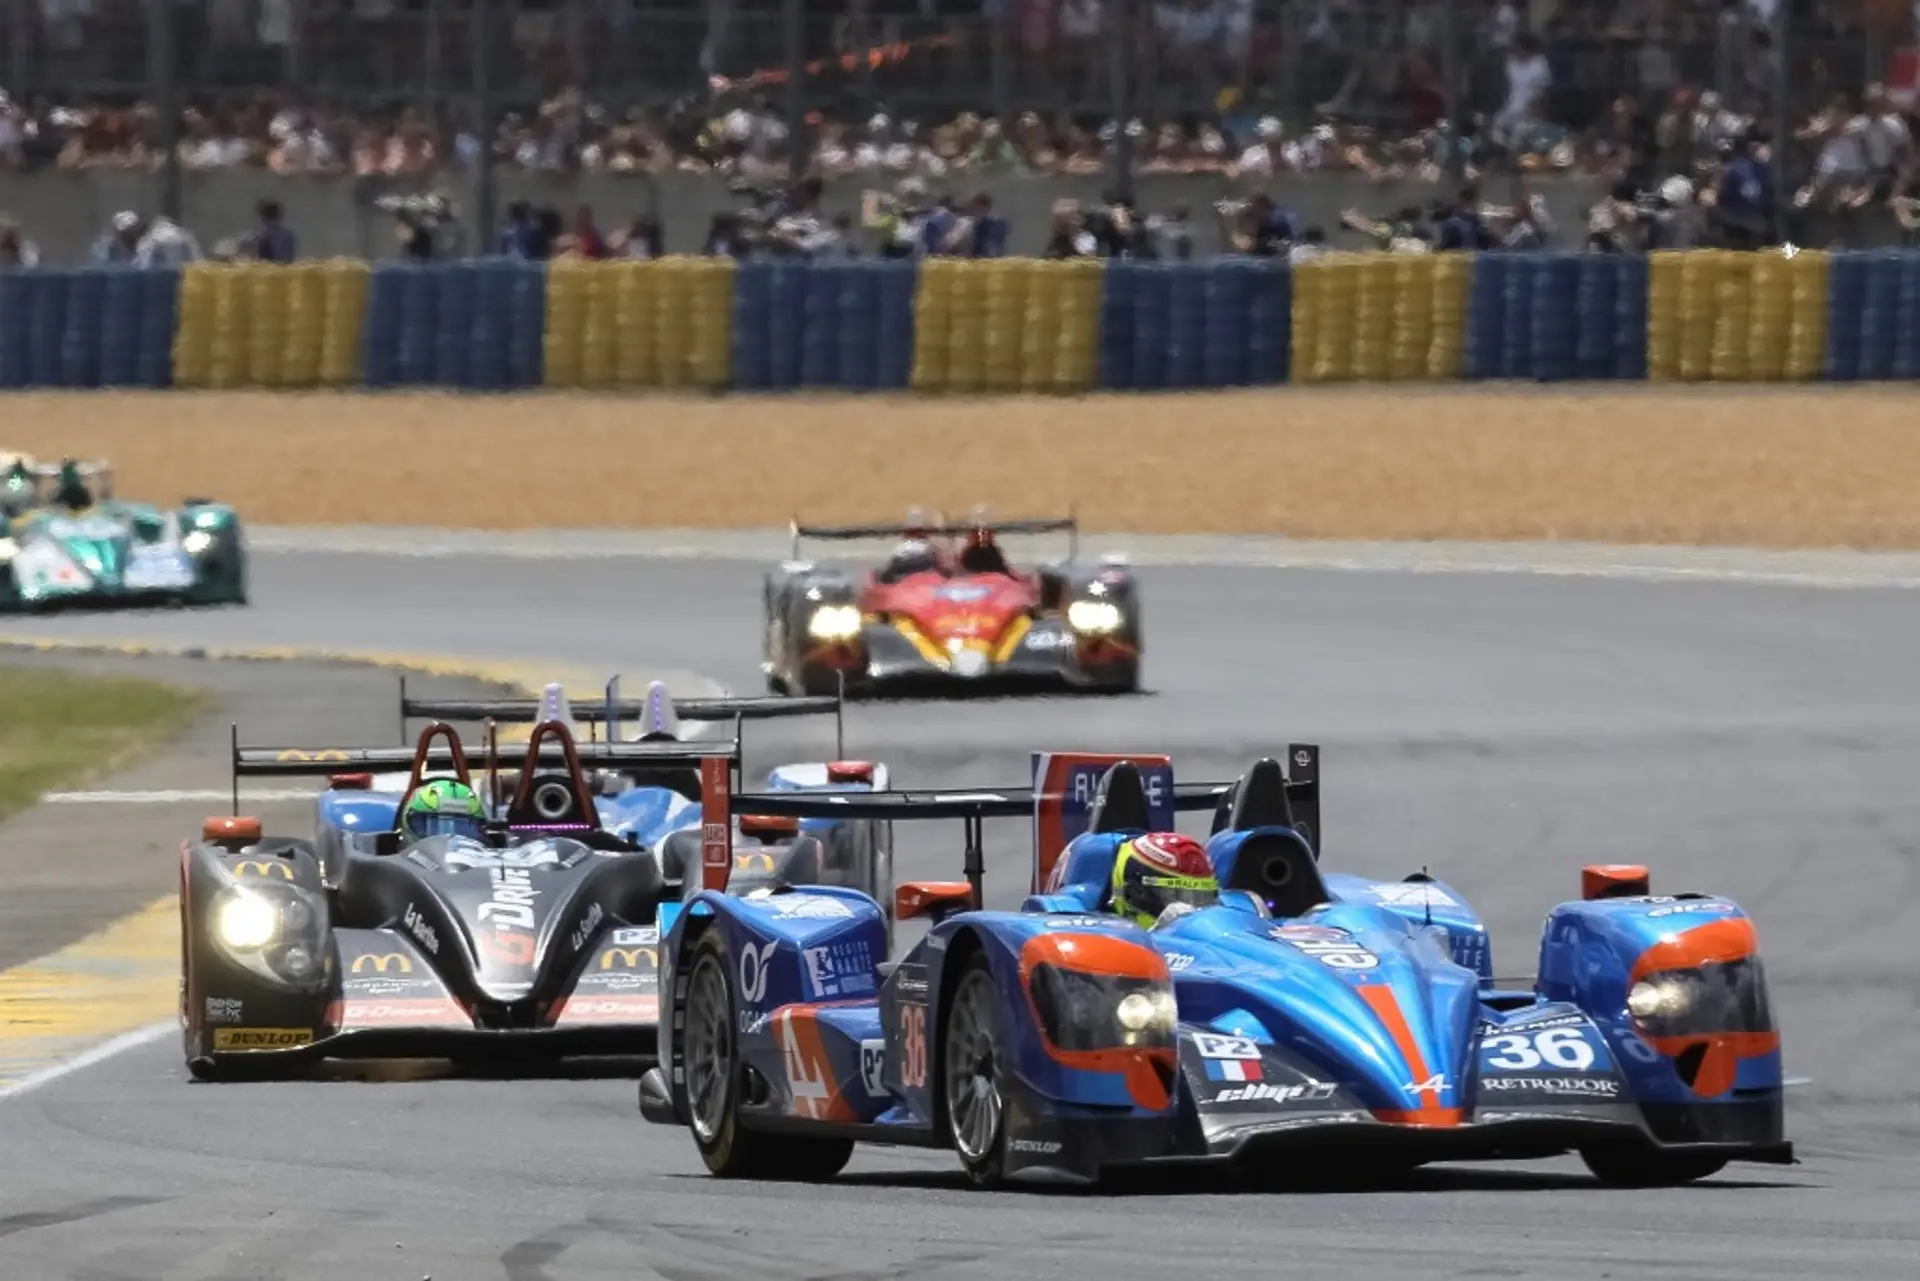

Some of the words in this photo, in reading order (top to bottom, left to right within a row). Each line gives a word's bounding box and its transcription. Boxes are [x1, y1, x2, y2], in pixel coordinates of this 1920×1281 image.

[229, 1031, 311, 1046] DUNLOP
[900, 1004, 927, 1088] 36
[1203, 1036, 1253, 1056] P2
[1479, 1027, 1595, 1071] 36
[1481, 1077, 1619, 1093] RETRODOR
